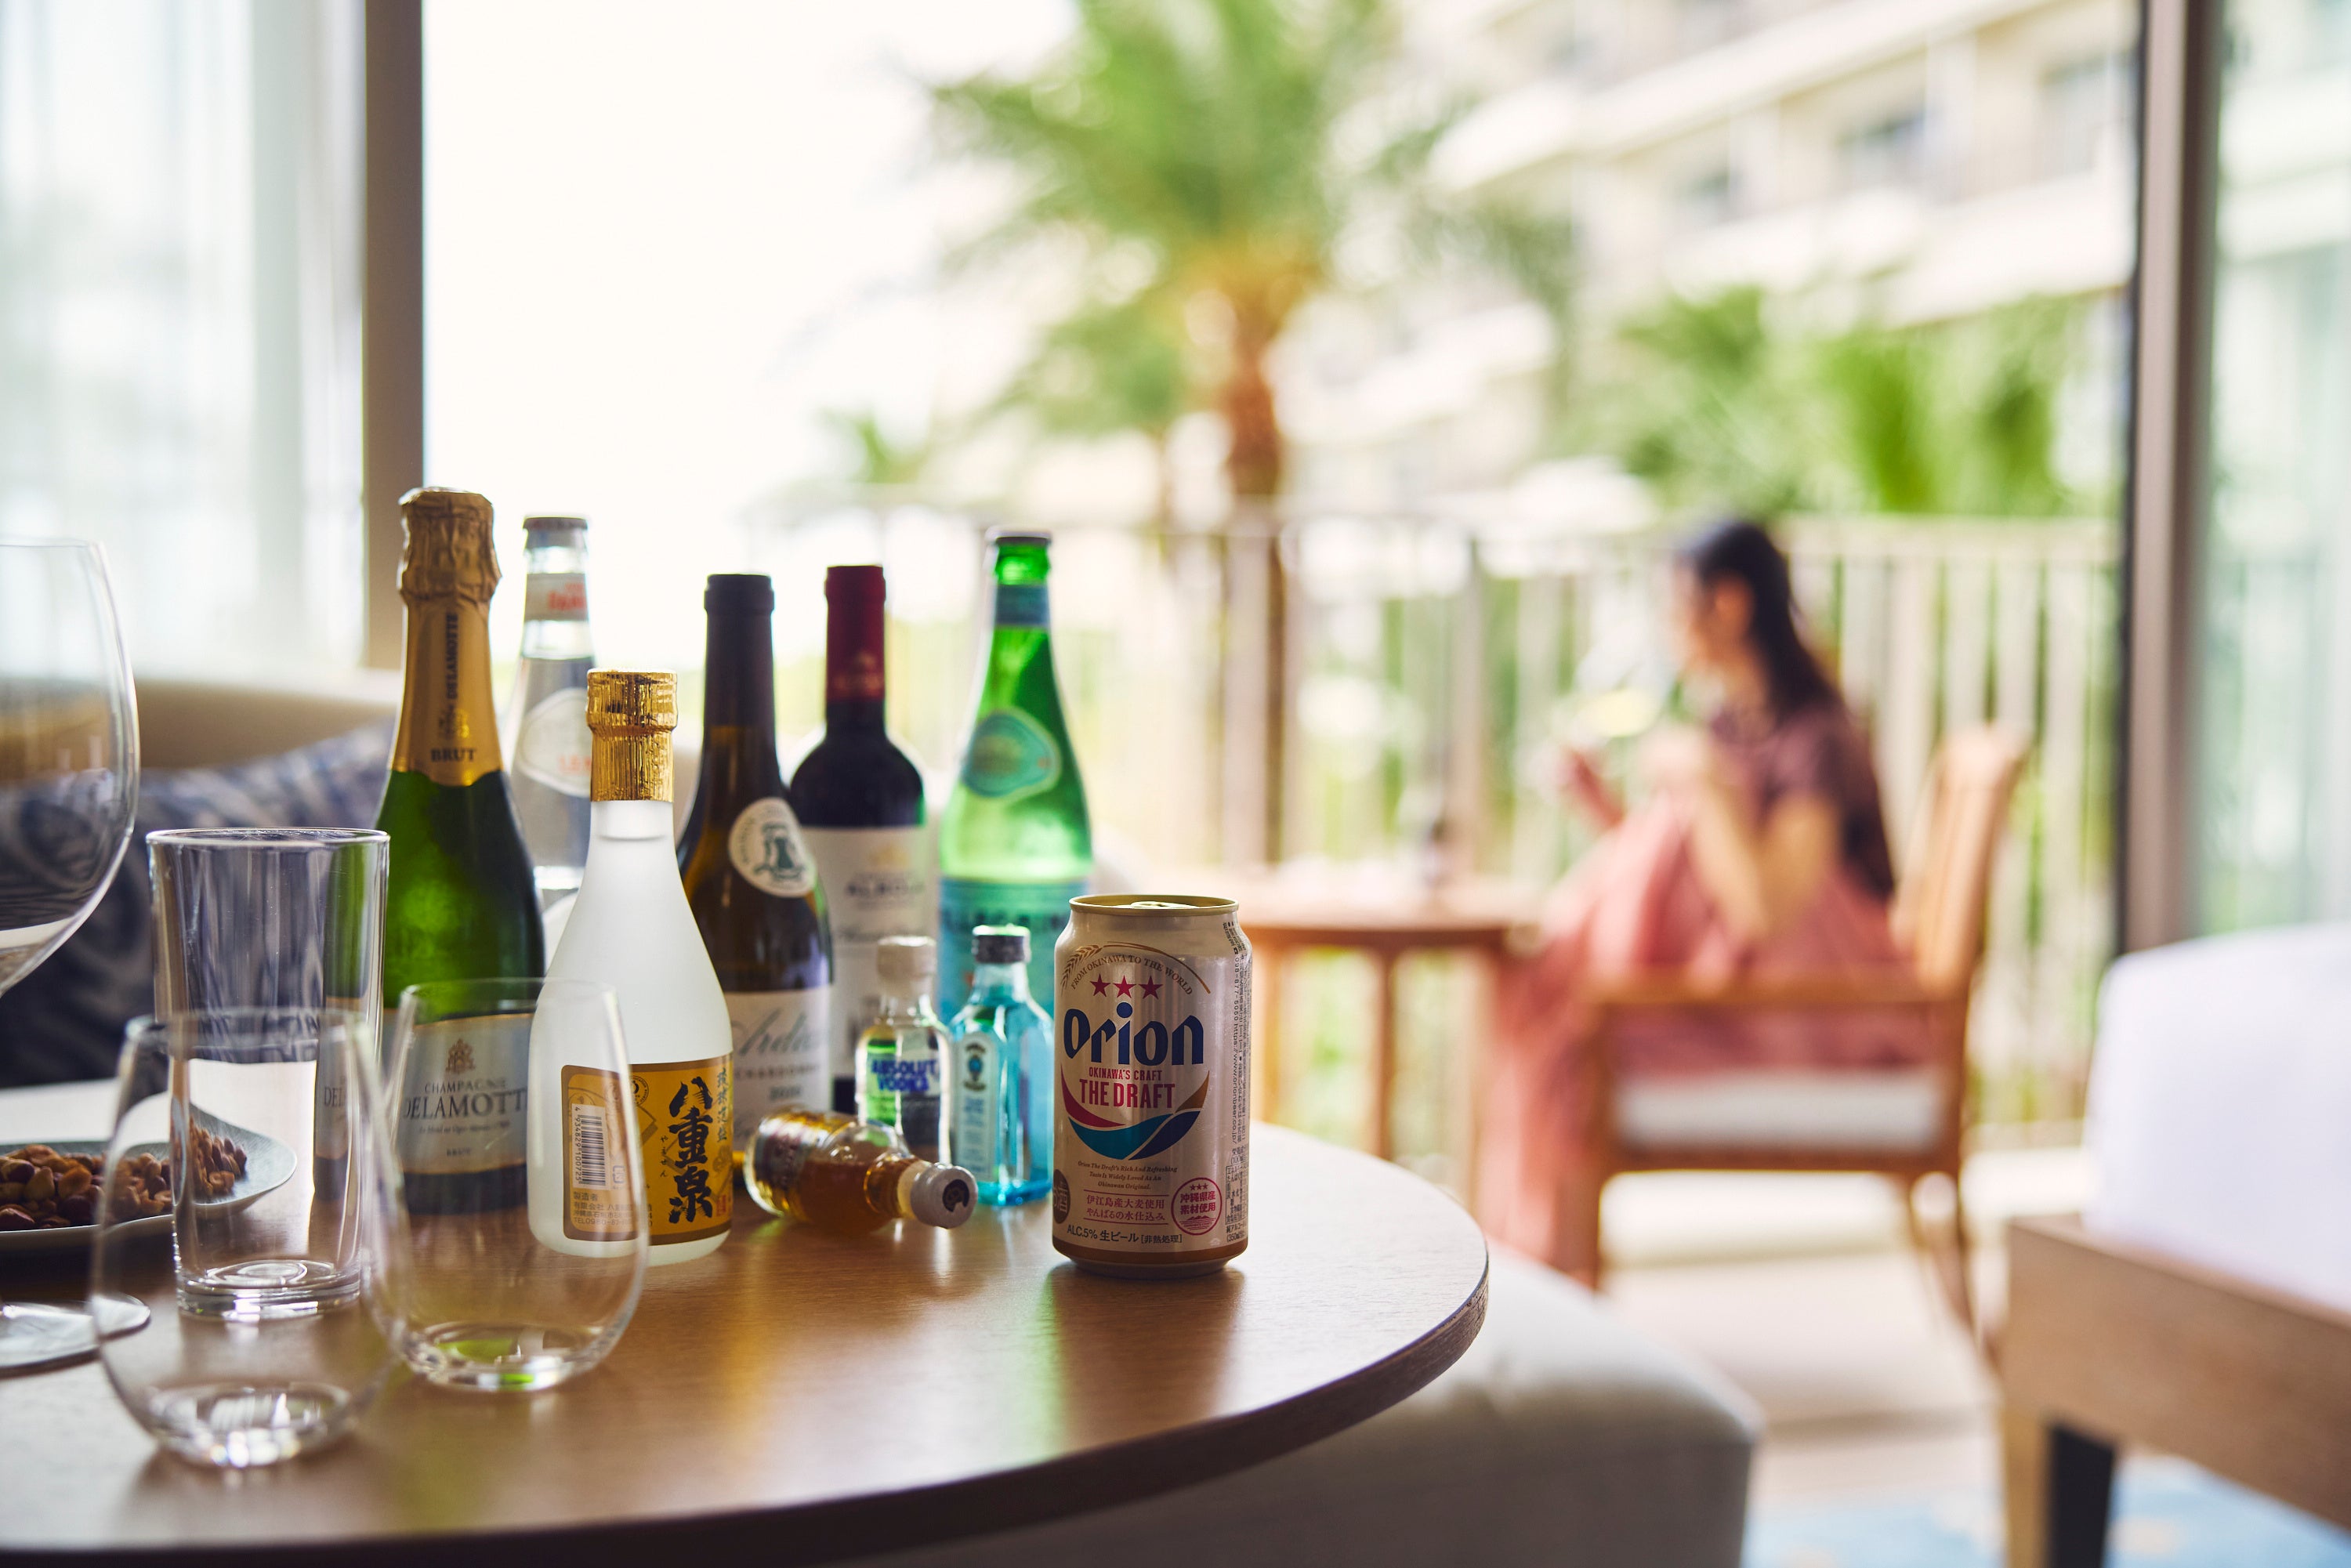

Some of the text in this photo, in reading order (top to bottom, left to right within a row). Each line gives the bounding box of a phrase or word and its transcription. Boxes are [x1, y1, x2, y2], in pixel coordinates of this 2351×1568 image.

[430, 748, 476, 762] BRUT
[1071, 955, 1193, 995] FROM OKINAWA TO THE WORLD
[1063, 1002, 1204, 1066] Orion
[1089, 1066, 1162, 1081] OKINAWA'S CRAFT
[1079, 1078, 1176, 1109] THE DRAFT
[406, 1087, 528, 1121] ELAMOTT
[668, 1076, 715, 1225] 八重泉
[1098, 1180, 1125, 1189] Okinawan
[1086, 1194, 1165, 1210] 伊江島産大麦使用
[1180, 1190, 1216, 1204] 沖縄県産
[1086, 1208, 1165, 1222] やんばるの水仕込み
[1180, 1202, 1216, 1215] 素材使用
[1067, 1224, 1098, 1240] ALC.5%
[1099, 1229, 1139, 1243] 生ビール
